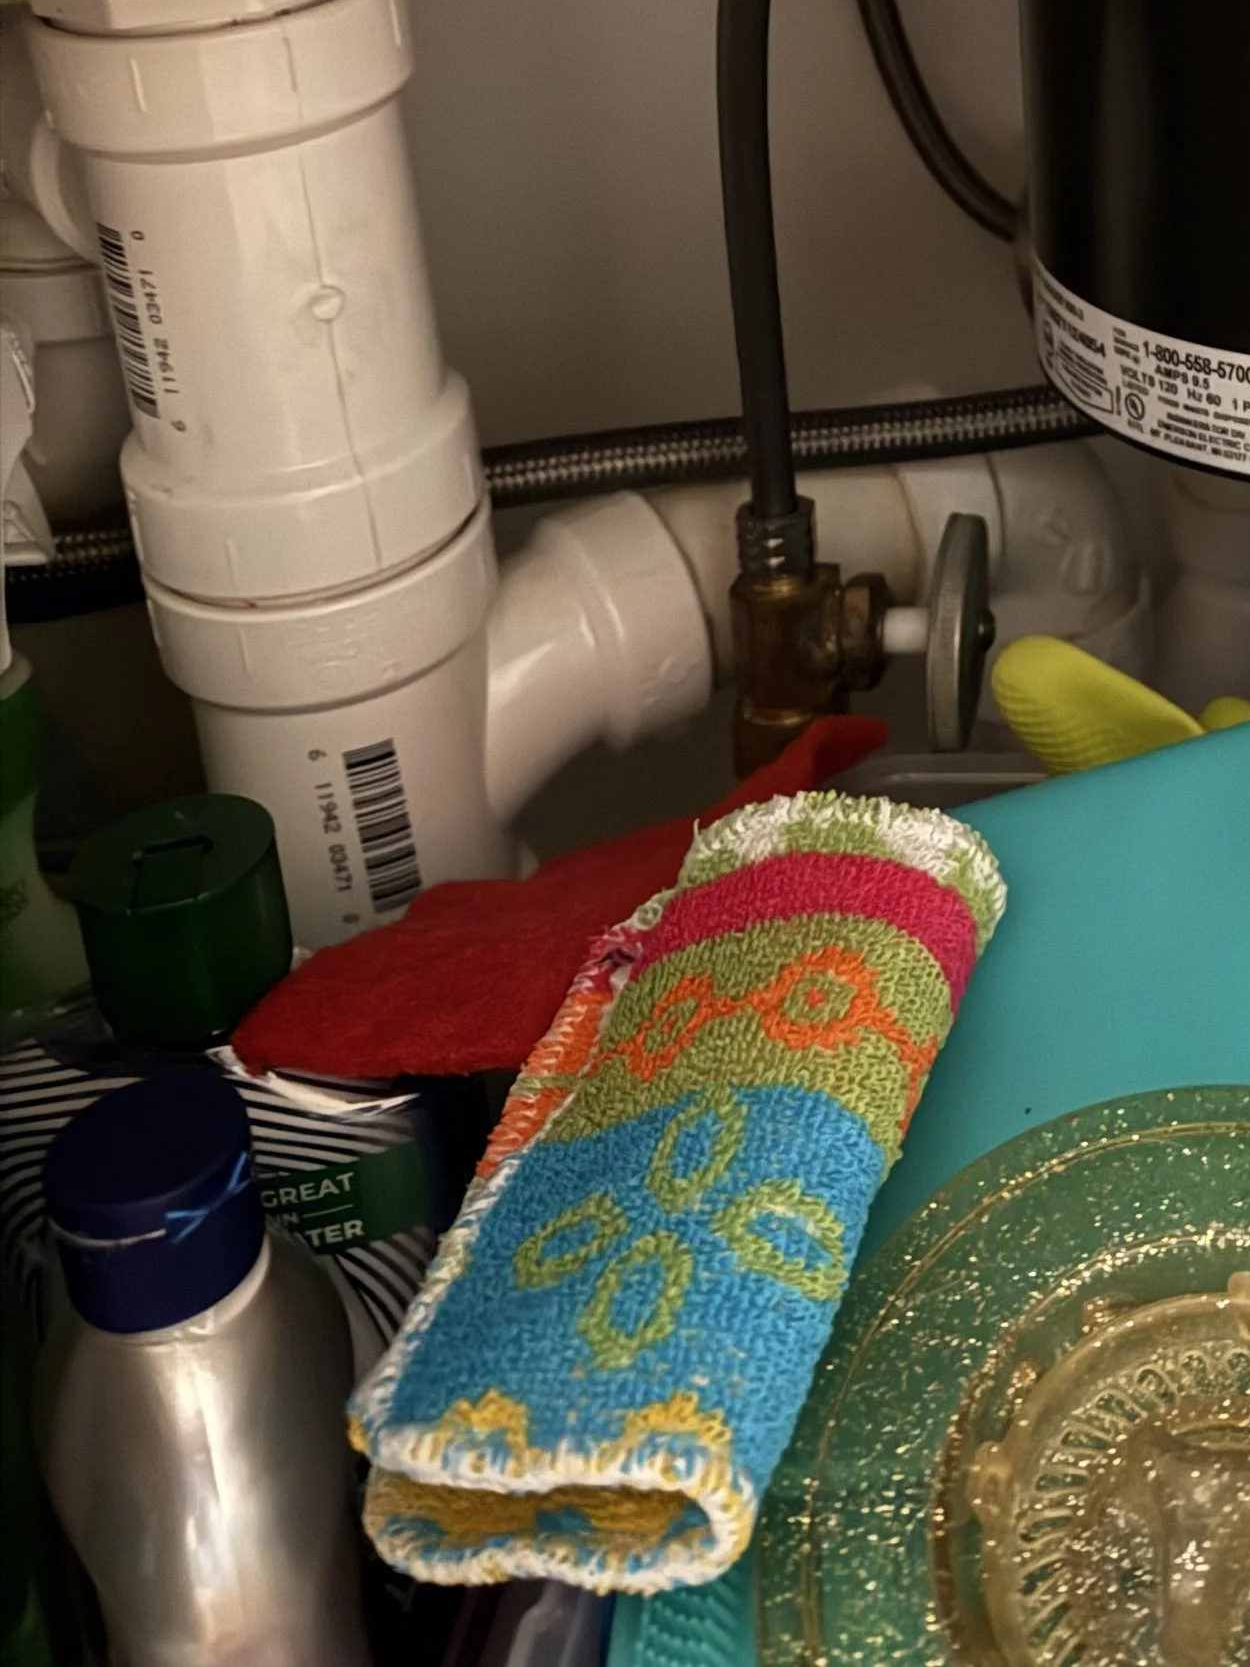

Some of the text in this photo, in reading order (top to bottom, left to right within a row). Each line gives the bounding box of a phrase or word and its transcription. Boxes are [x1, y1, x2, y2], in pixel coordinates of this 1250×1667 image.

[1154, 364, 1189, 385] AMPS
[314, 782, 342, 834] 11942
[260, 1172, 354, 1207] GREAT
